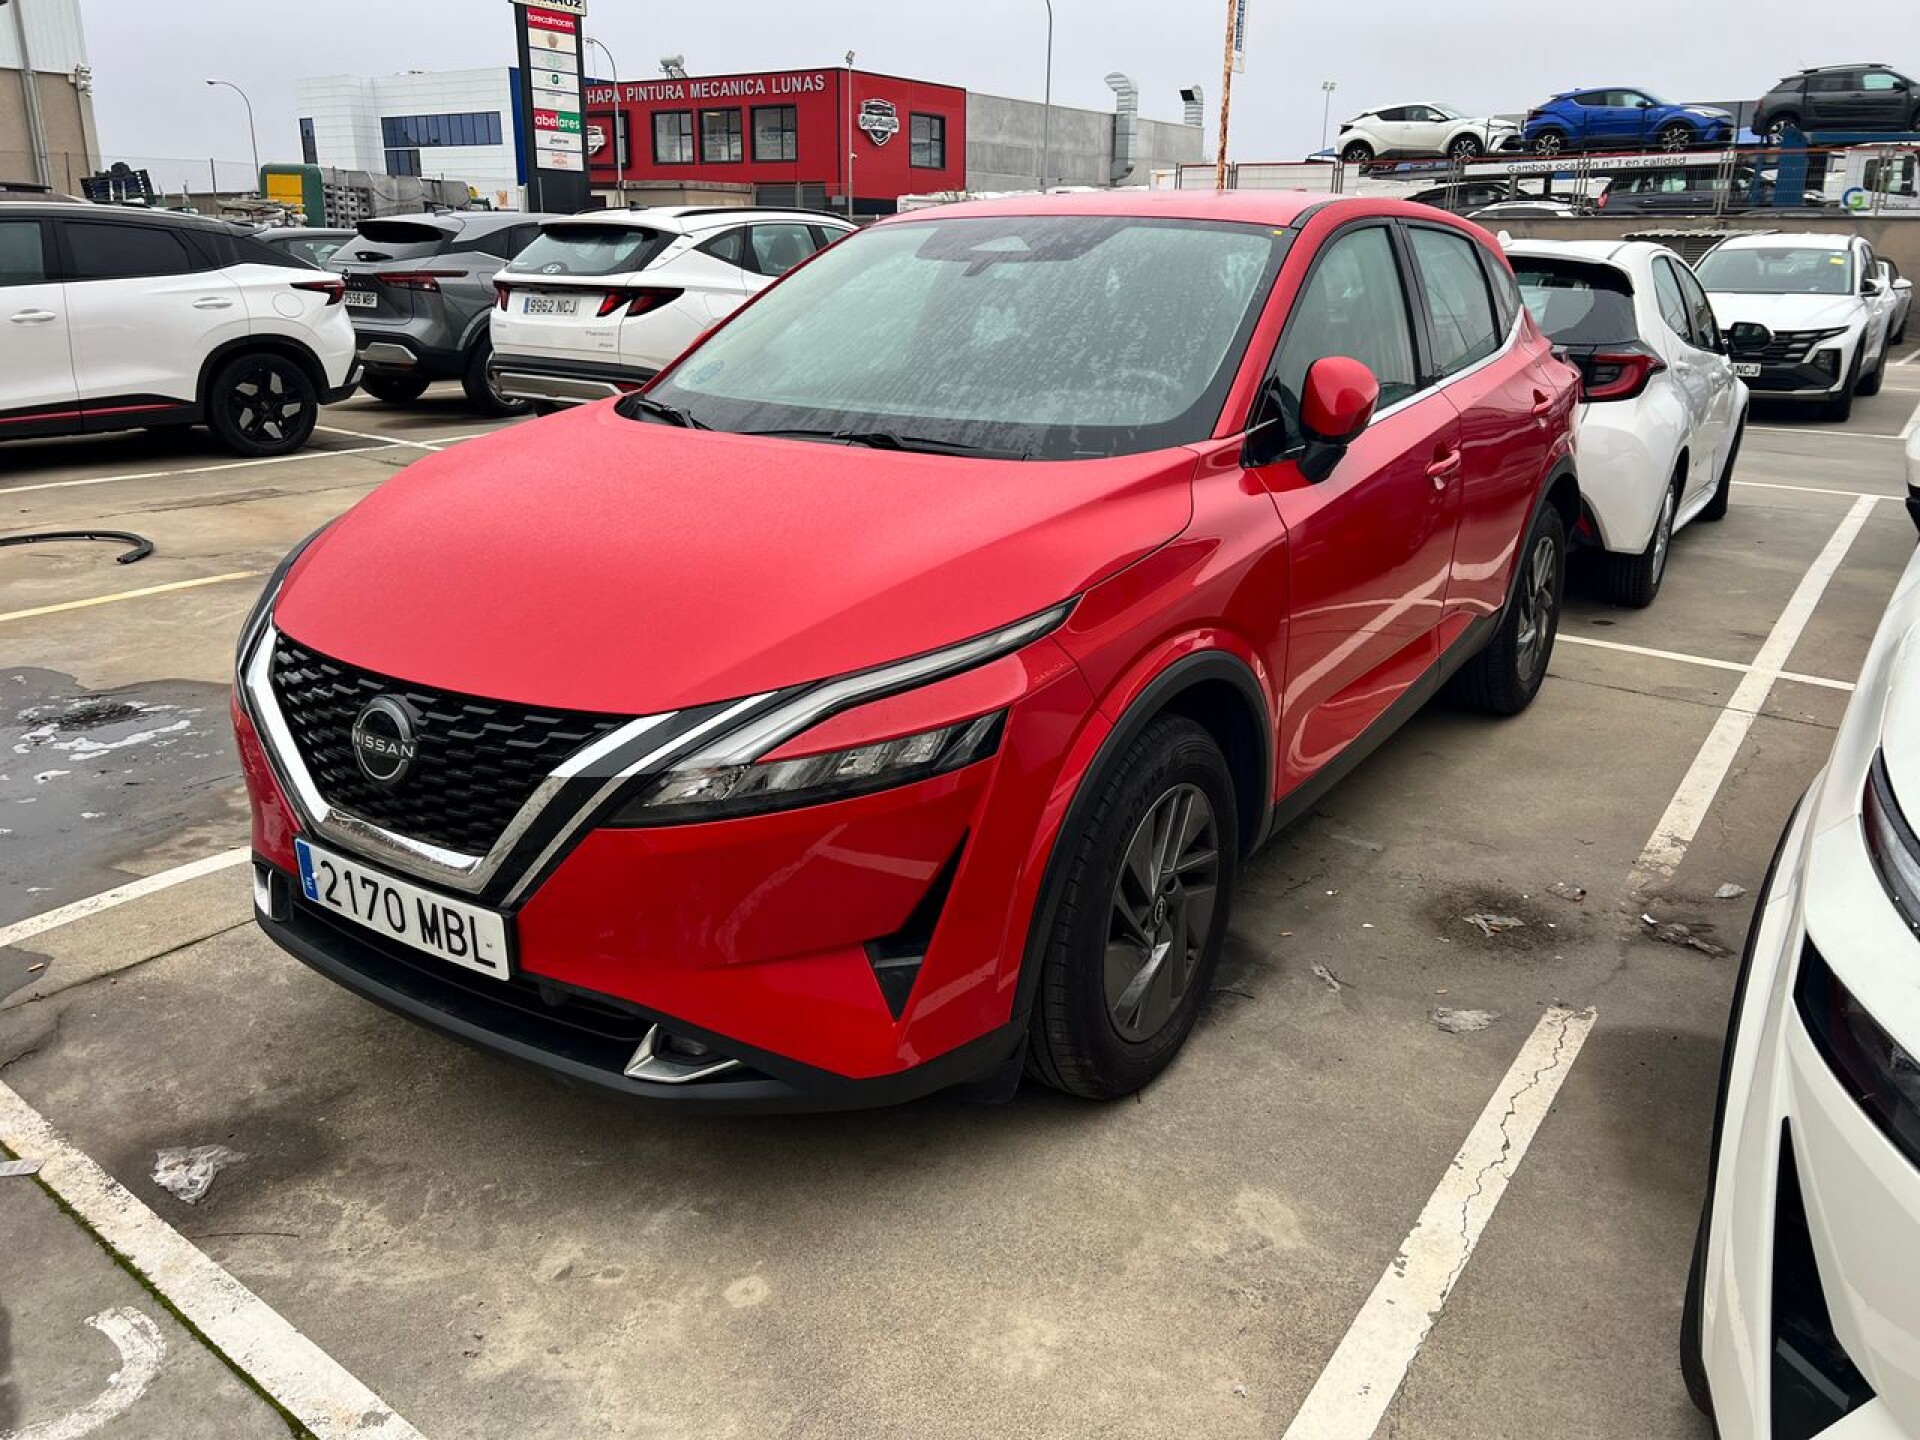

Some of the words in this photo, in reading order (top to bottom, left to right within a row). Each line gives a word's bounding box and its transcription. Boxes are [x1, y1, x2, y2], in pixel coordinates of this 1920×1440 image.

[586, 87, 622, 104] HAPA
[626, 84, 684, 102] PINTURA
[690, 79, 766, 98] MECANICA
[772, 74, 825, 94] LUNAS
[535, 113, 581, 129] abelares
[1507, 162, 1552, 173] Gamboa
[1626, 159, 1640, 168] en
[1643, 156, 1687, 167] calidad
[556, 299, 577, 313] NCJ
[1735, 365, 1759, 376] NCJ
[352, 727, 414, 757] NISSAN
[320, 860, 406, 934] 2170
[416, 897, 497, 969] MBL
